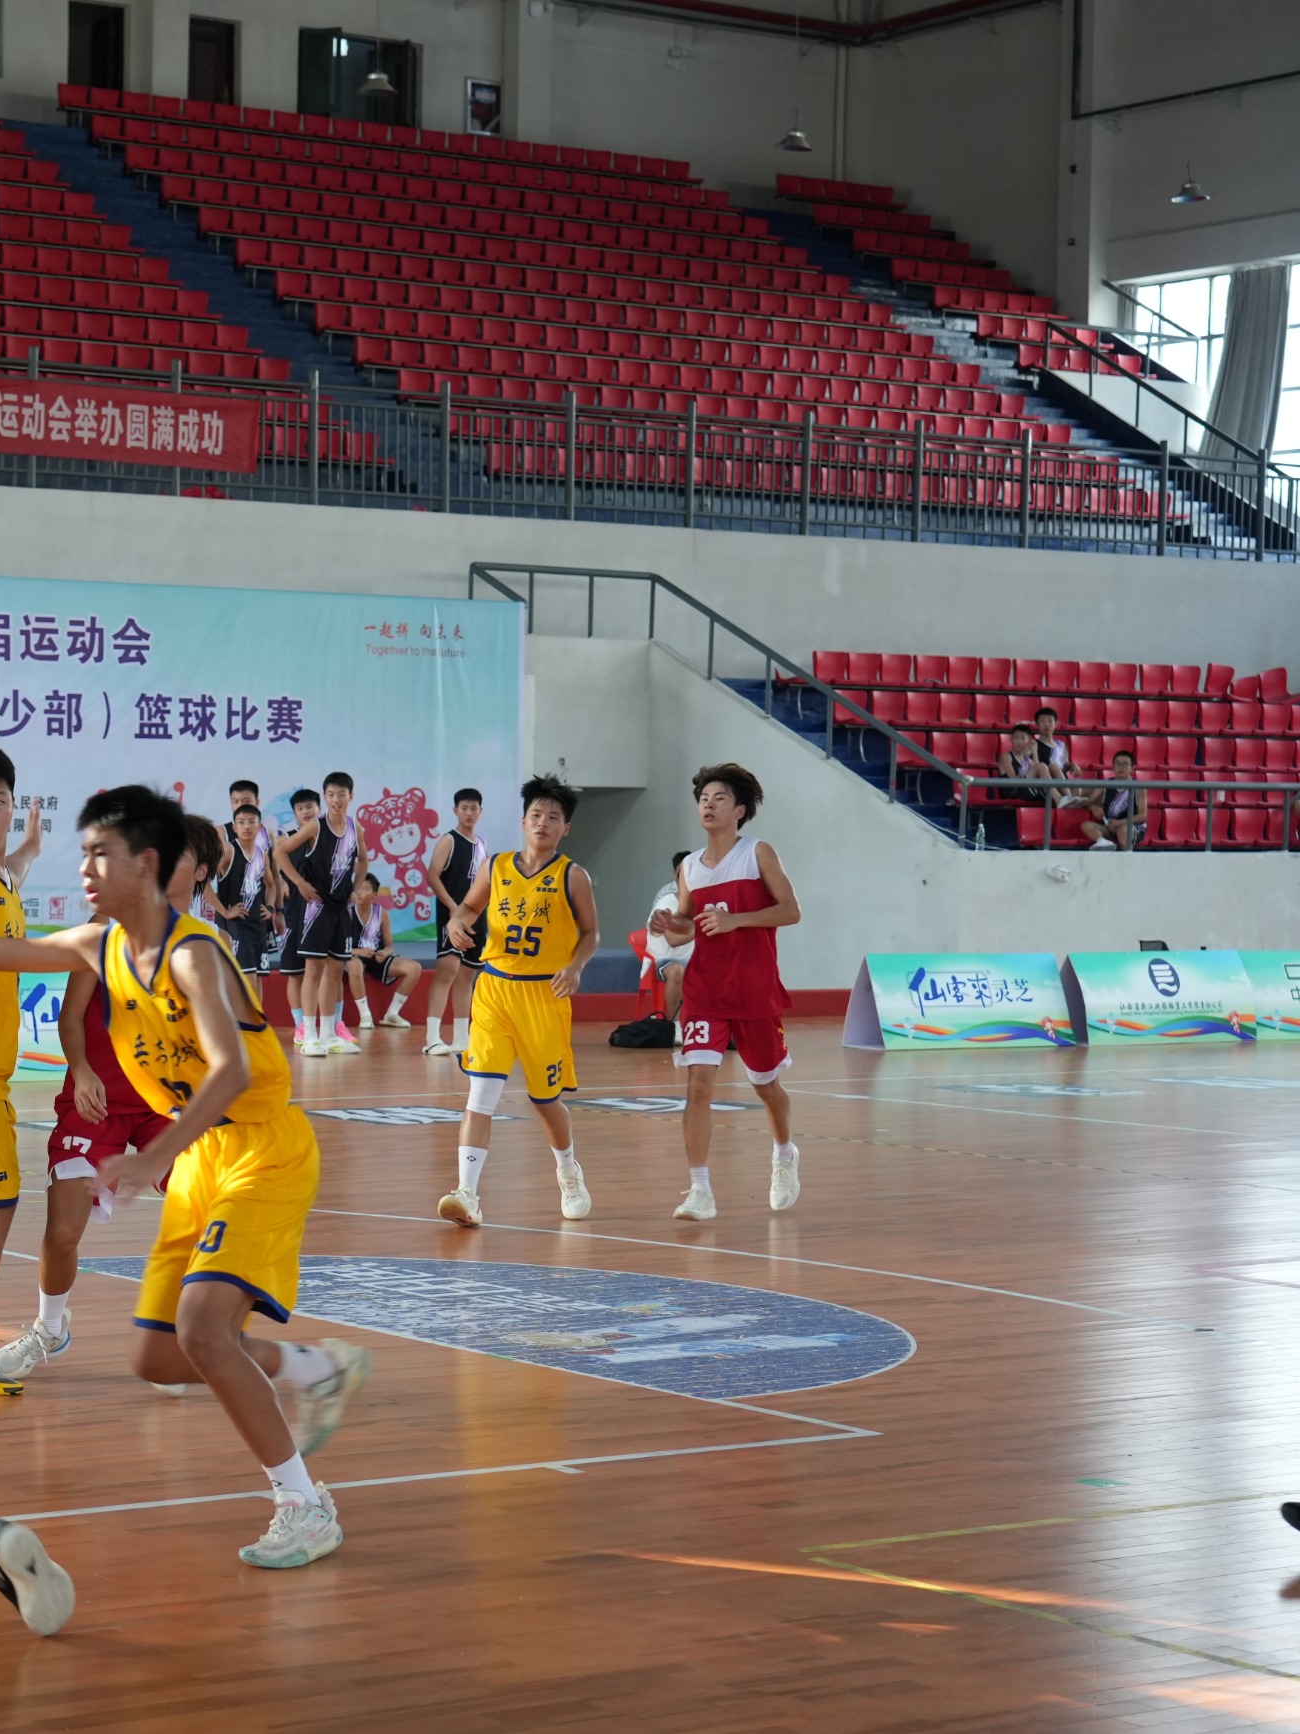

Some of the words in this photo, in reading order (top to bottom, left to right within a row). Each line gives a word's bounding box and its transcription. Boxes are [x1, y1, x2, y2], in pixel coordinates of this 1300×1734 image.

[366, 643, 409, 657] Together
[410, 646, 420, 656] to
[421, 647, 437, 657] the
[504, 924, 543, 957] 25
[683, 1020, 710, 1046] 23
[62, 1136, 92, 1155] 17
